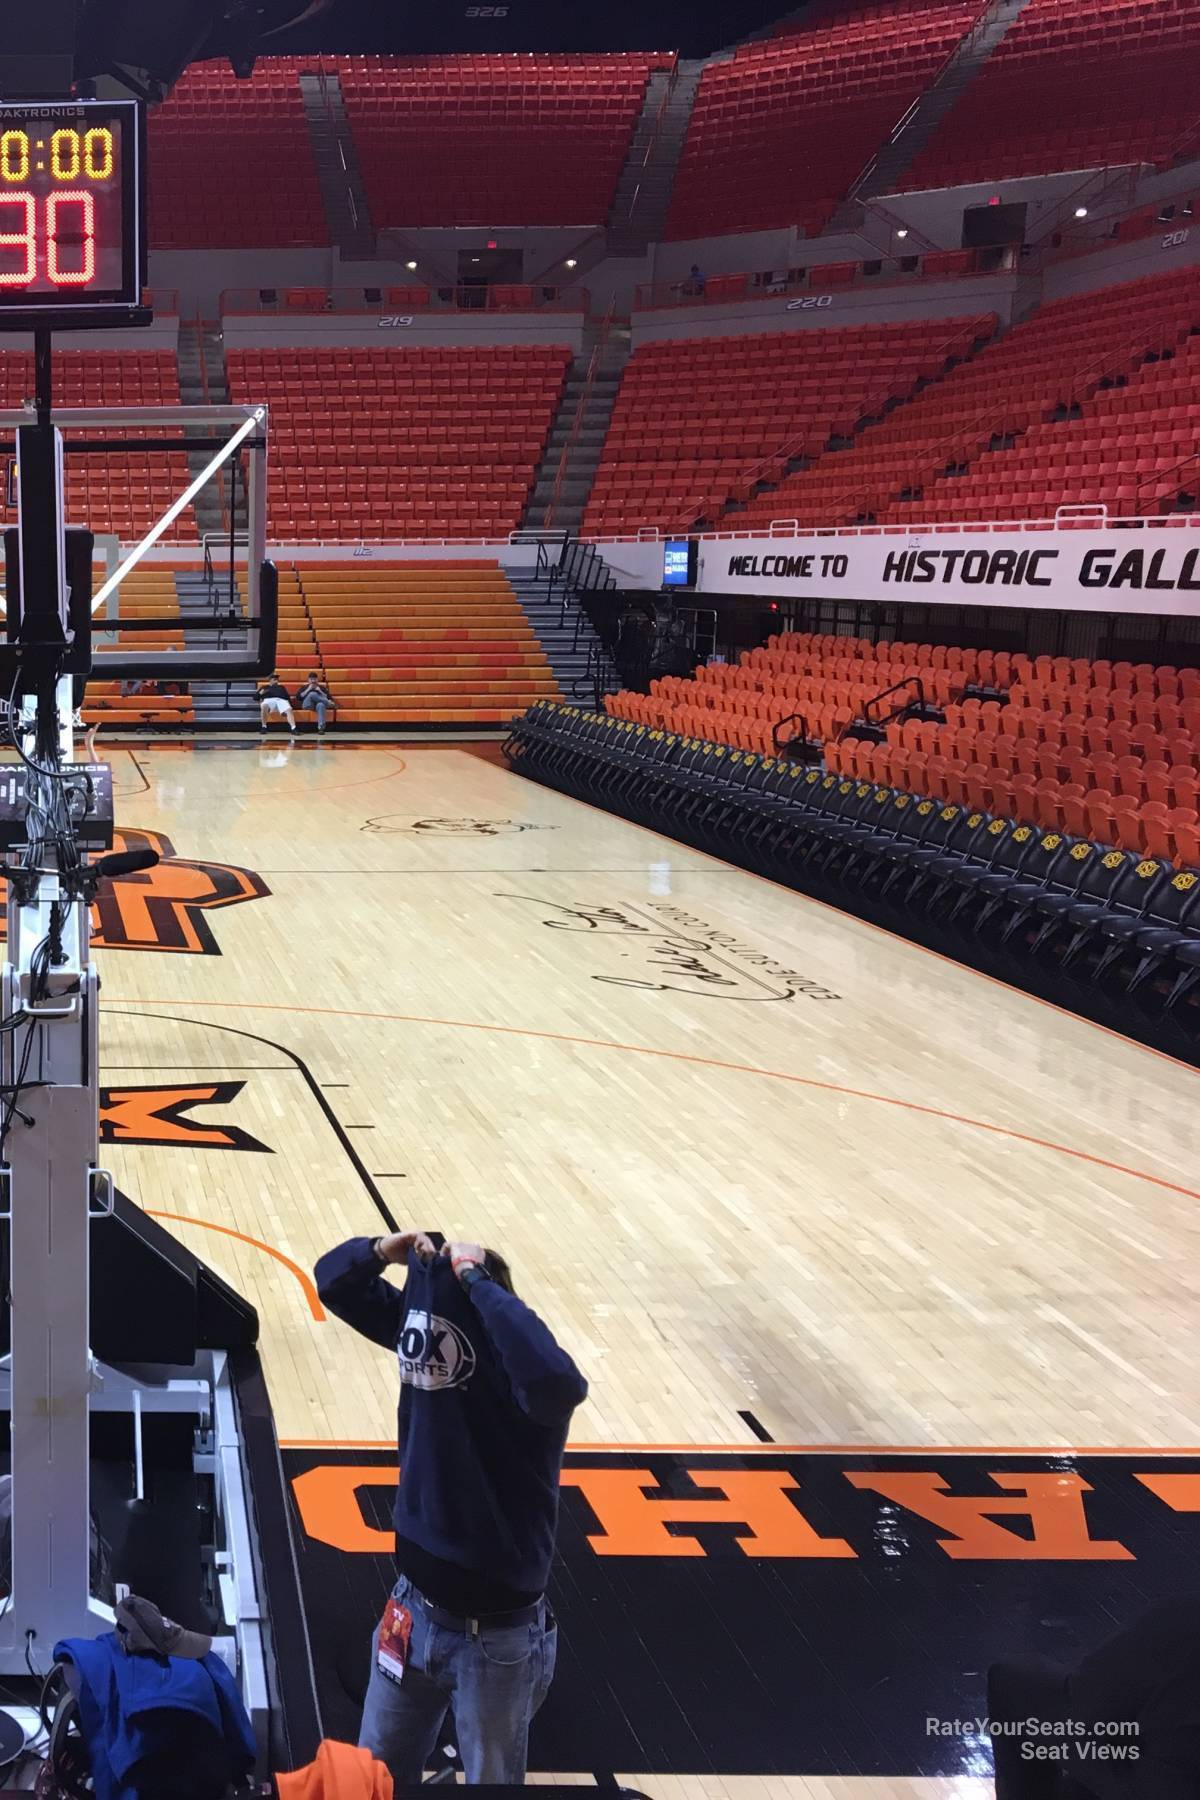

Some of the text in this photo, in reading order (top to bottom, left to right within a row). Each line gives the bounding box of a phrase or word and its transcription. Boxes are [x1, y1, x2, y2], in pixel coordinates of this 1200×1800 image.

[787, 295, 832, 309] 220
[379, 316, 413, 327] 219
[728, 548, 1200, 590] WELCOME TO HISTORIC GALL
[646, 902, 842, 1000] EDDIE SUTTON COURT
